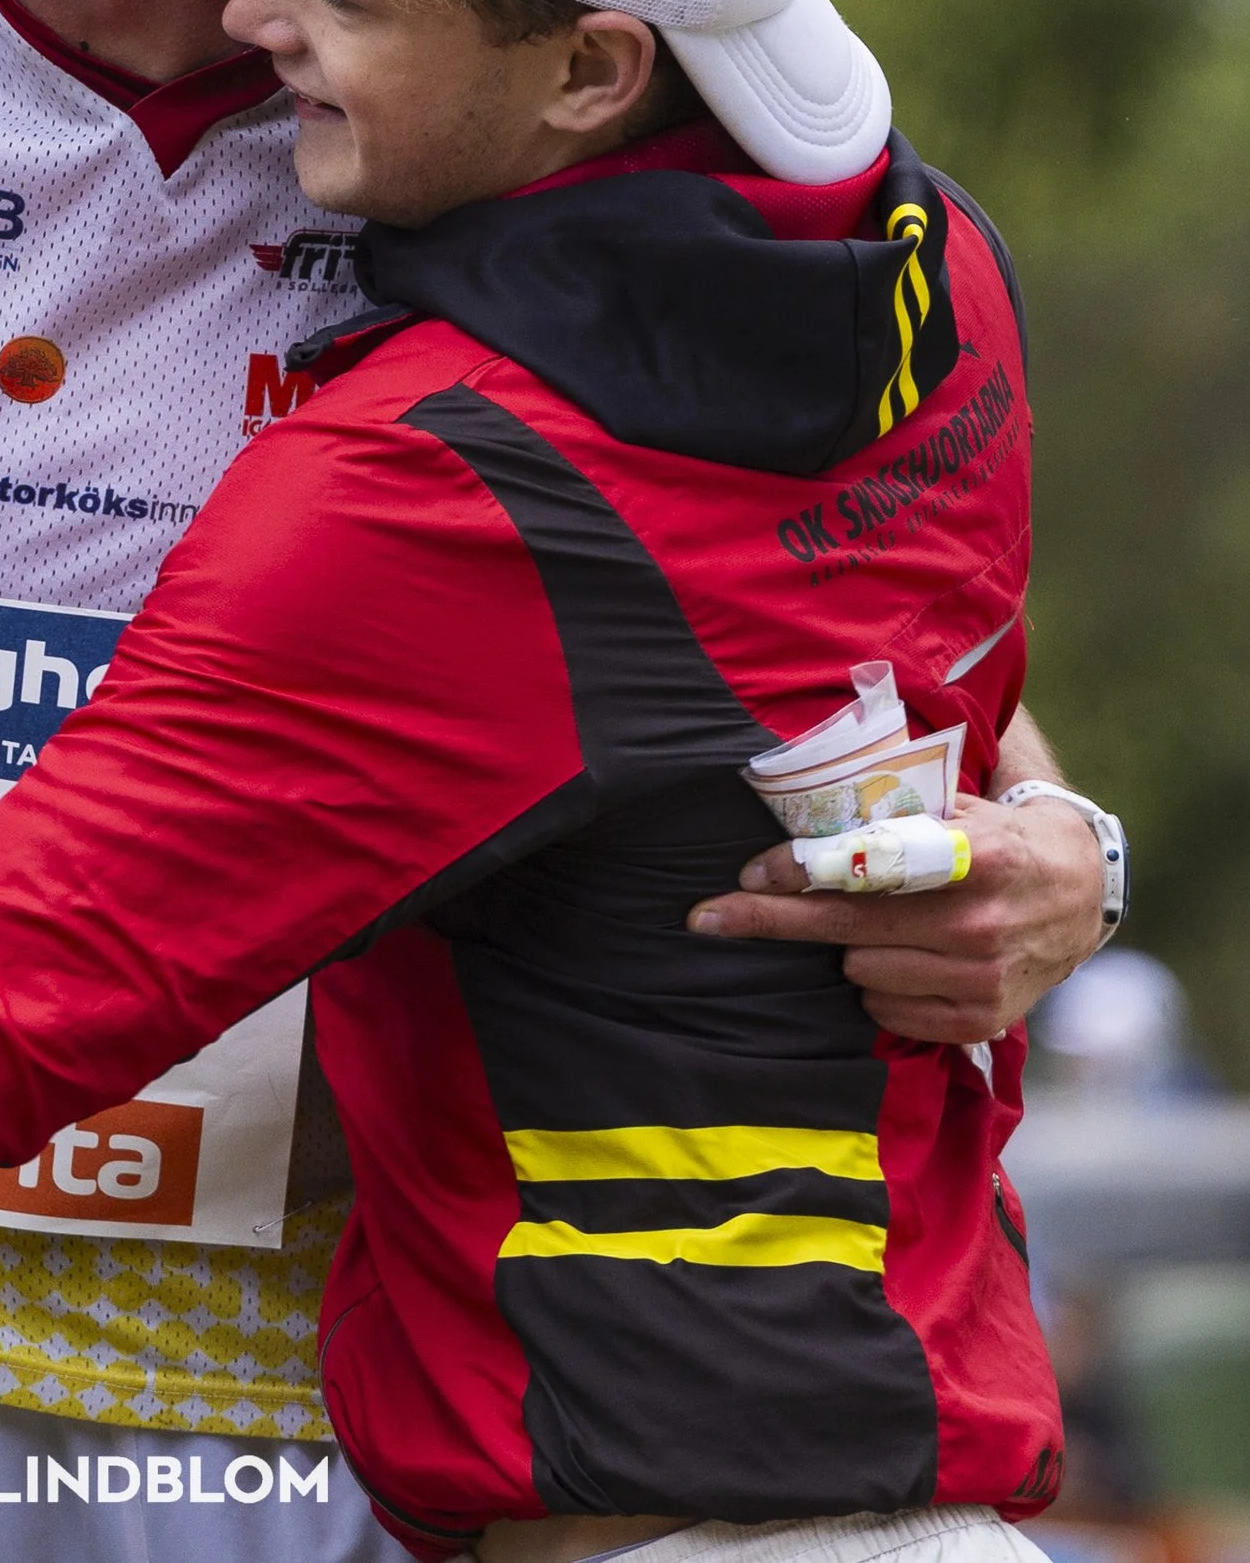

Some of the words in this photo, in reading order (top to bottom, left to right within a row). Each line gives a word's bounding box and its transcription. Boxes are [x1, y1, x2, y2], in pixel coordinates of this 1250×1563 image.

[279, 232, 362, 281] fri
[287, 280, 359, 297] SOLLEBR
[244, 352, 318, 419] M
[241, 418, 270, 437] IC
[777, 502, 841, 563] OK
